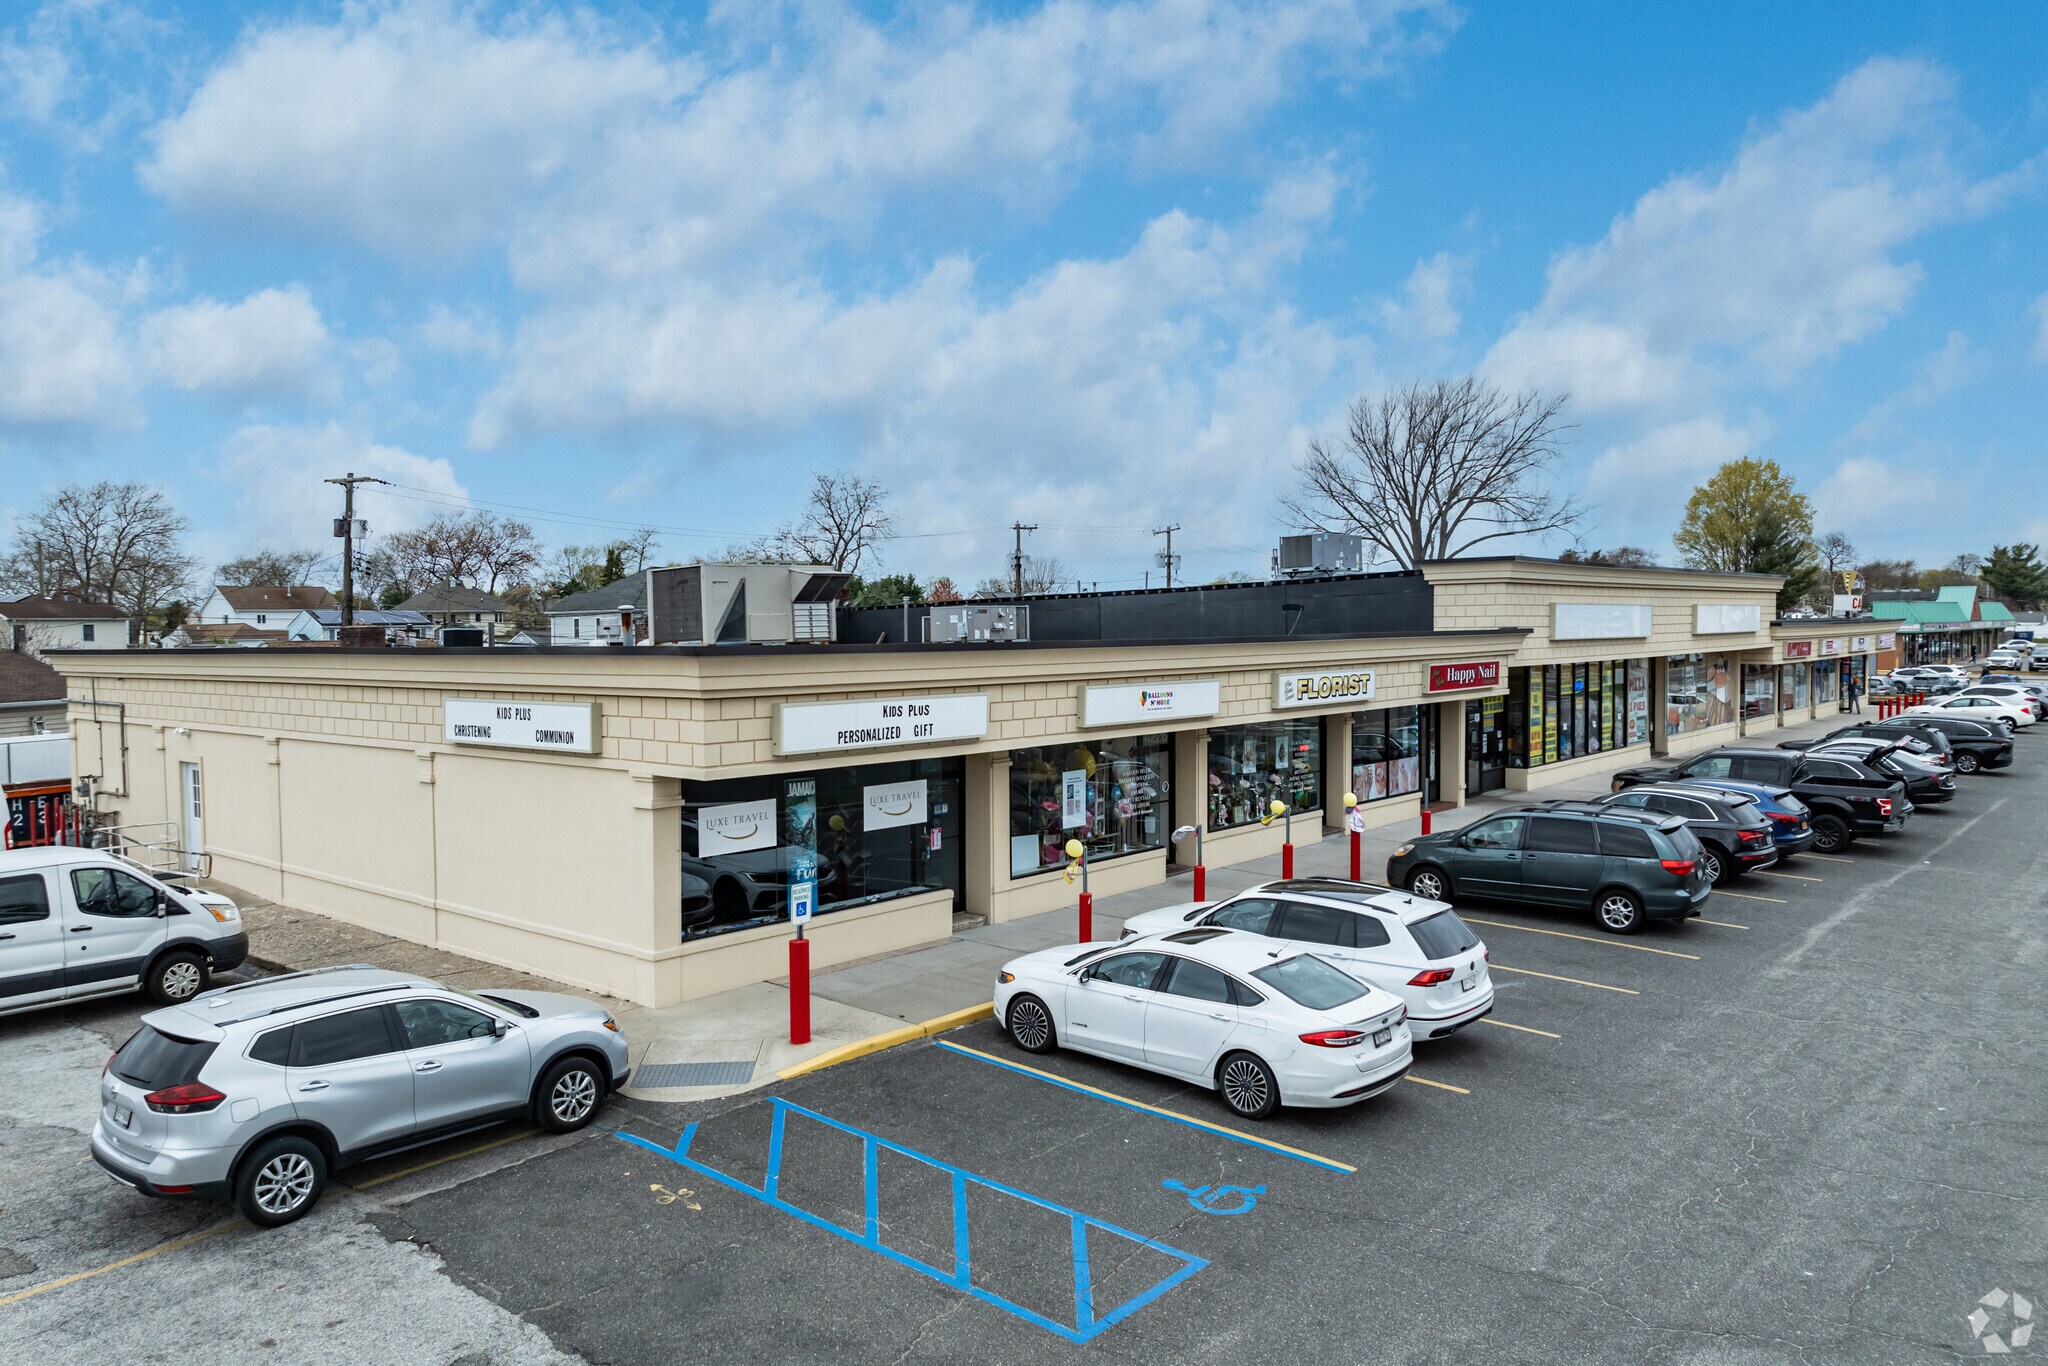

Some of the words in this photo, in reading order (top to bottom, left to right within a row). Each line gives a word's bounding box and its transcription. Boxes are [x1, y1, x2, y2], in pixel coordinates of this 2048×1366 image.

[1447, 668, 1476, 684] Happy
[1479, 664, 1496, 678] Nail
[1297, 674, 1370, 700] FLORIST
[1629, 677, 1646, 691] PIZZA
[883, 705, 903, 718] KIDS
[908, 704, 930, 717] PLUS
[1634, 701, 1645, 711] PIES
[496, 707, 511, 720] KIDS
[515, 708, 531, 721] PLUS
[454, 724, 491, 739] CHRISTENING
[535, 730, 574, 744] COMMUNION
[838, 726, 900, 745] PERSONALIZED
[914, 723, 934, 737] GIFT
[870, 794, 888, 807] LUXE
[891, 791, 921, 802] TRAVEL
[706, 816, 729, 830] LUXE
[733, 811, 769, 825] TRAVEL
[793, 893, 810, 901] PARKING
